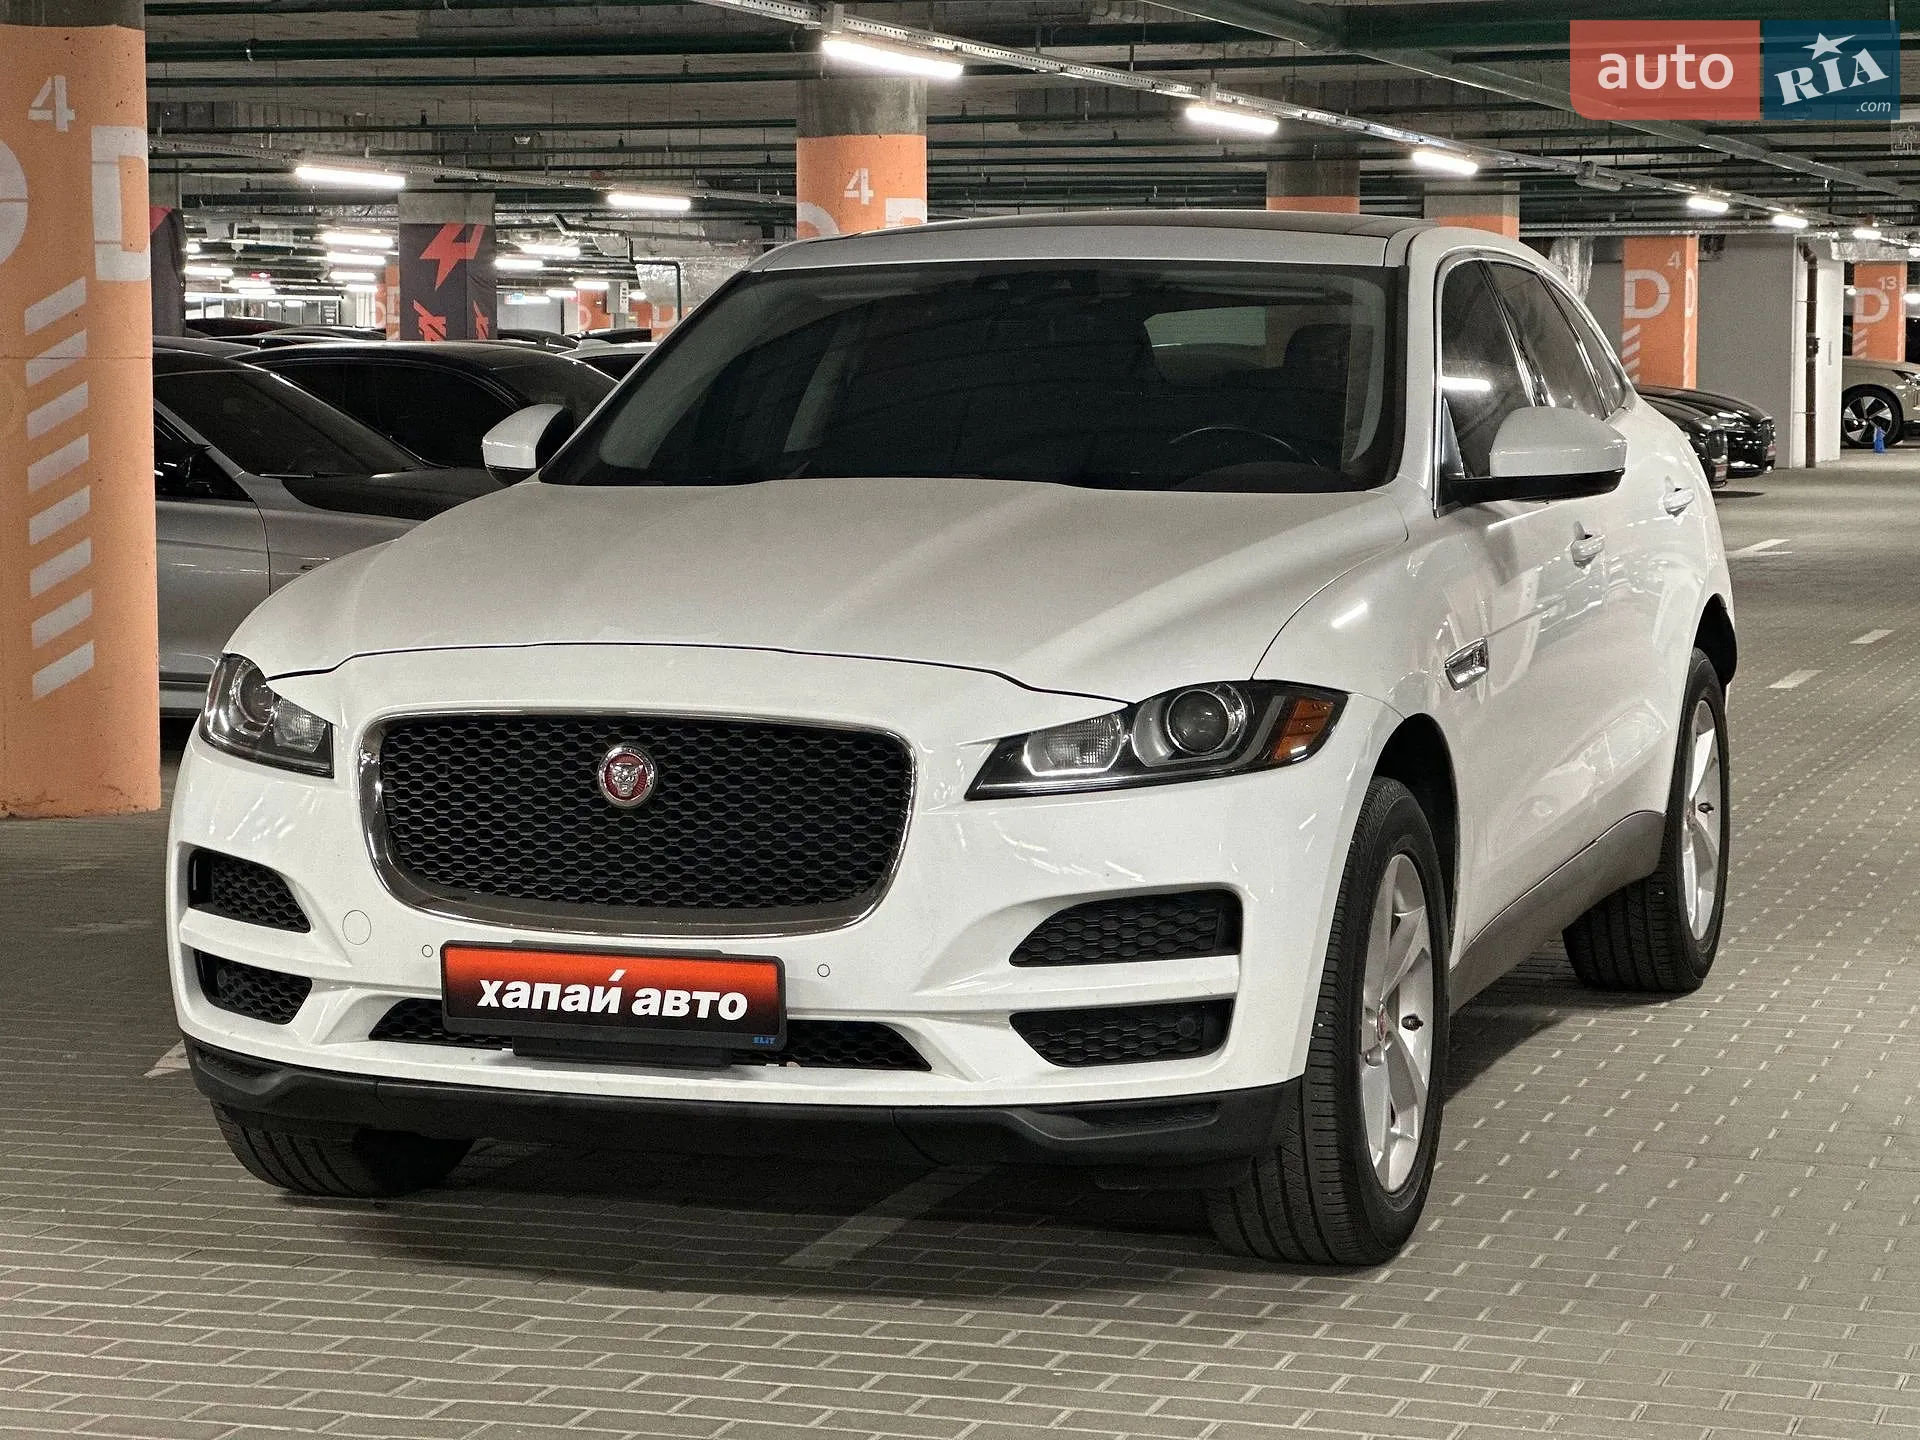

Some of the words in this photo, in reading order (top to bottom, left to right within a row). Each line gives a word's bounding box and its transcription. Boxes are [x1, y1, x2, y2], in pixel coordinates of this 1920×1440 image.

[28, 75, 76, 132] 4
[844, 167, 874, 206] 4
[1667, 250, 1681, 270] 4
[1623, 269, 1671, 319] D
[1879, 275, 1898, 290] 13
[1853, 287, 1890, 323] D
[476, 969, 627, 1014] хапай
[631, 986, 748, 1021] авто
